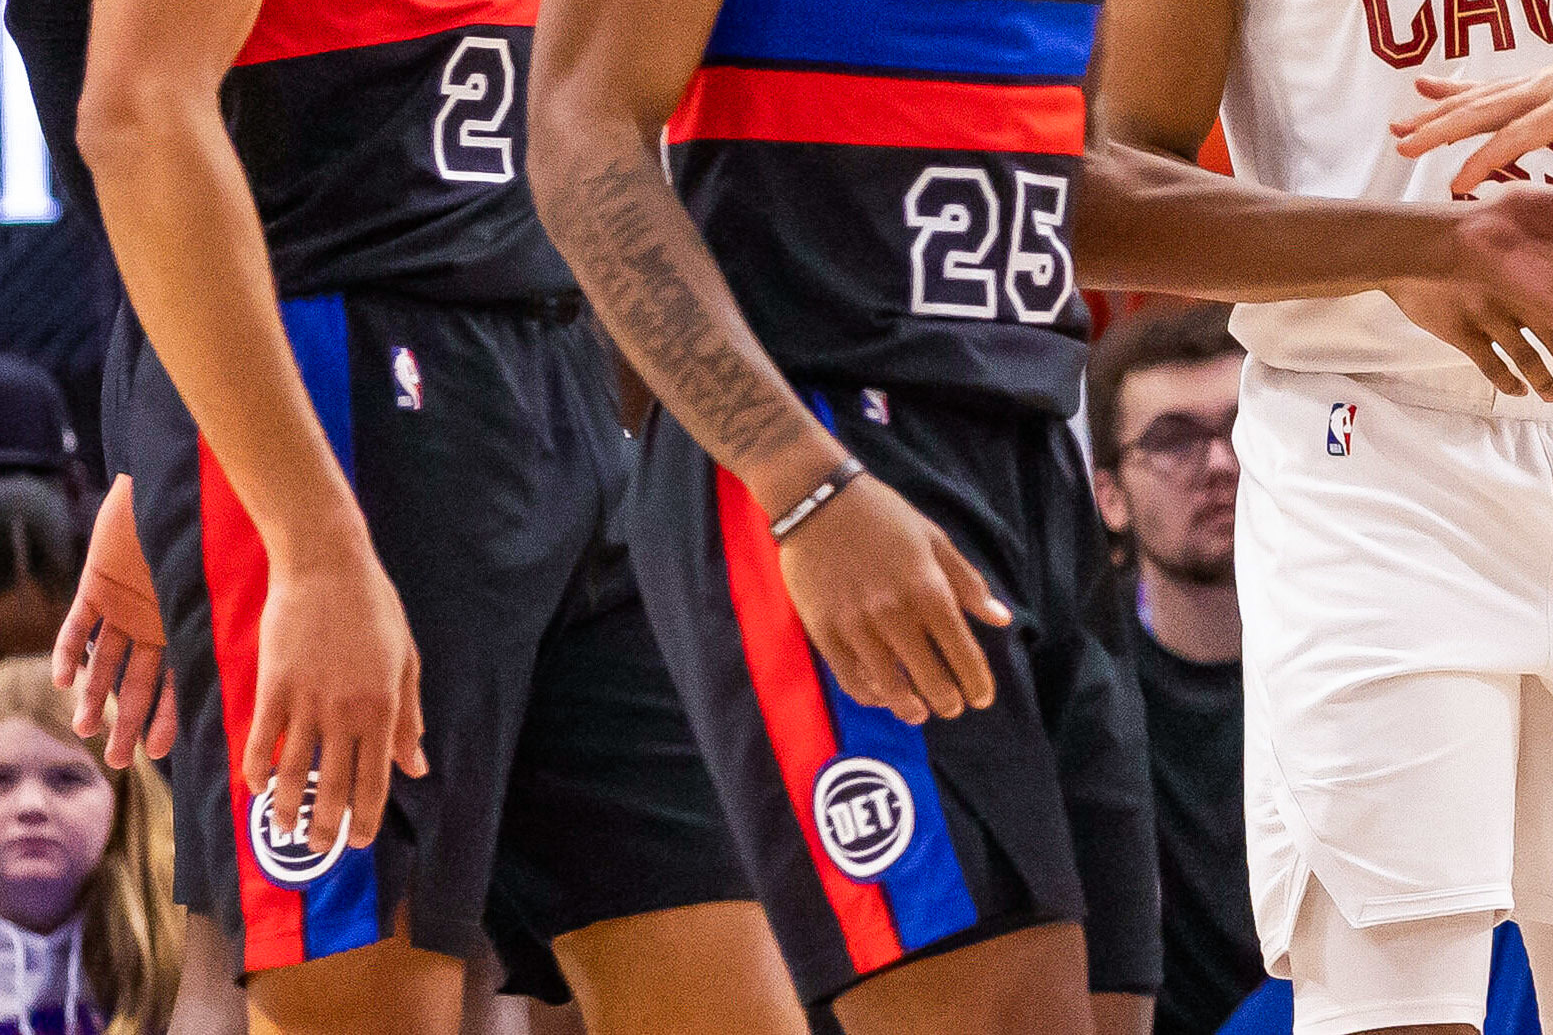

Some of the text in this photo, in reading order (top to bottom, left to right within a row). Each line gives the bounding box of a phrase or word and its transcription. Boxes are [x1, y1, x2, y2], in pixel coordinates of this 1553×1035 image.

[433, 36, 516, 183] 2
[904, 166, 1074, 324] 25
[827, 787, 891, 845] DET
